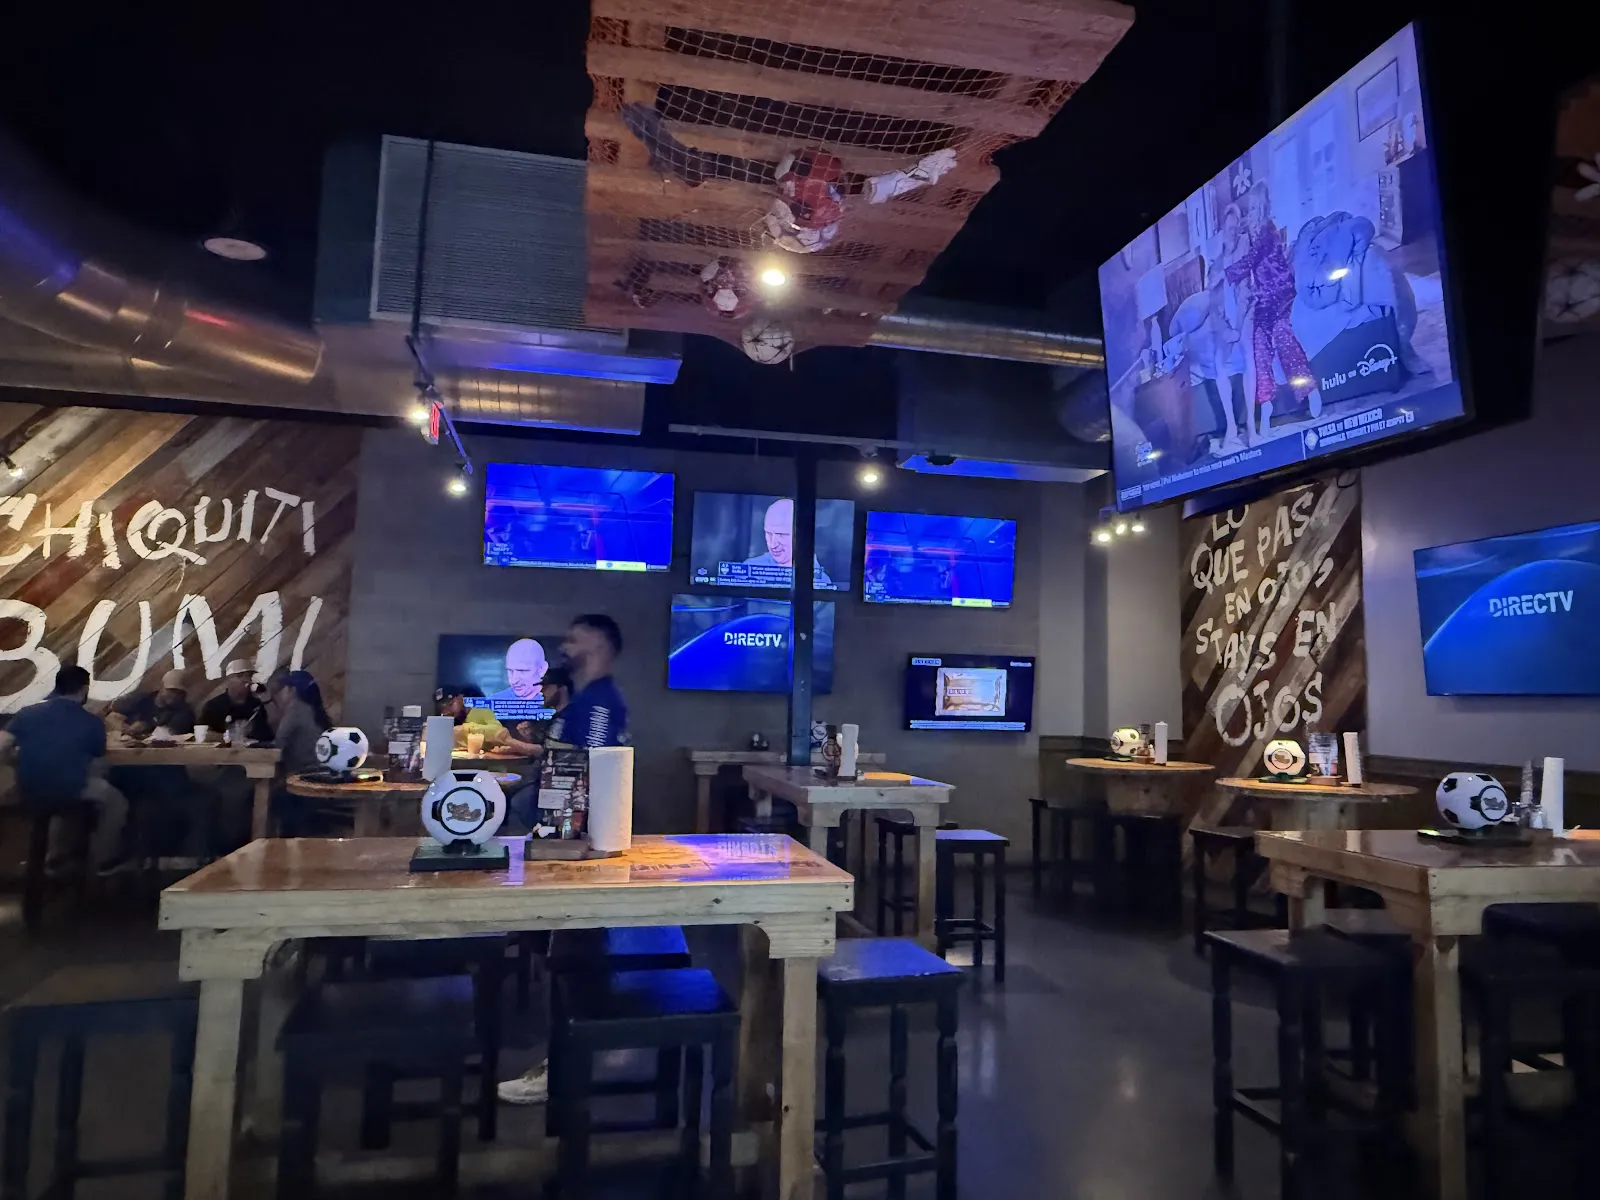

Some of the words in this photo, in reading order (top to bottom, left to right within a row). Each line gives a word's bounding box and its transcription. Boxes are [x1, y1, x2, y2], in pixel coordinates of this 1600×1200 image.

[1321, 372, 1347, 391] hulu
[1190, 539, 1250, 595] QUE
[1224, 587, 1252, 625] EN
[1257, 542, 1335, 607] OJOS
[1488, 590, 1574, 618] DIRECTV
[723, 631, 782, 648] DIRECTV
[1195, 617, 1278, 681] STAYS
[1292, 601, 1337, 660] EN
[1215, 671, 1323, 747] OJOS
